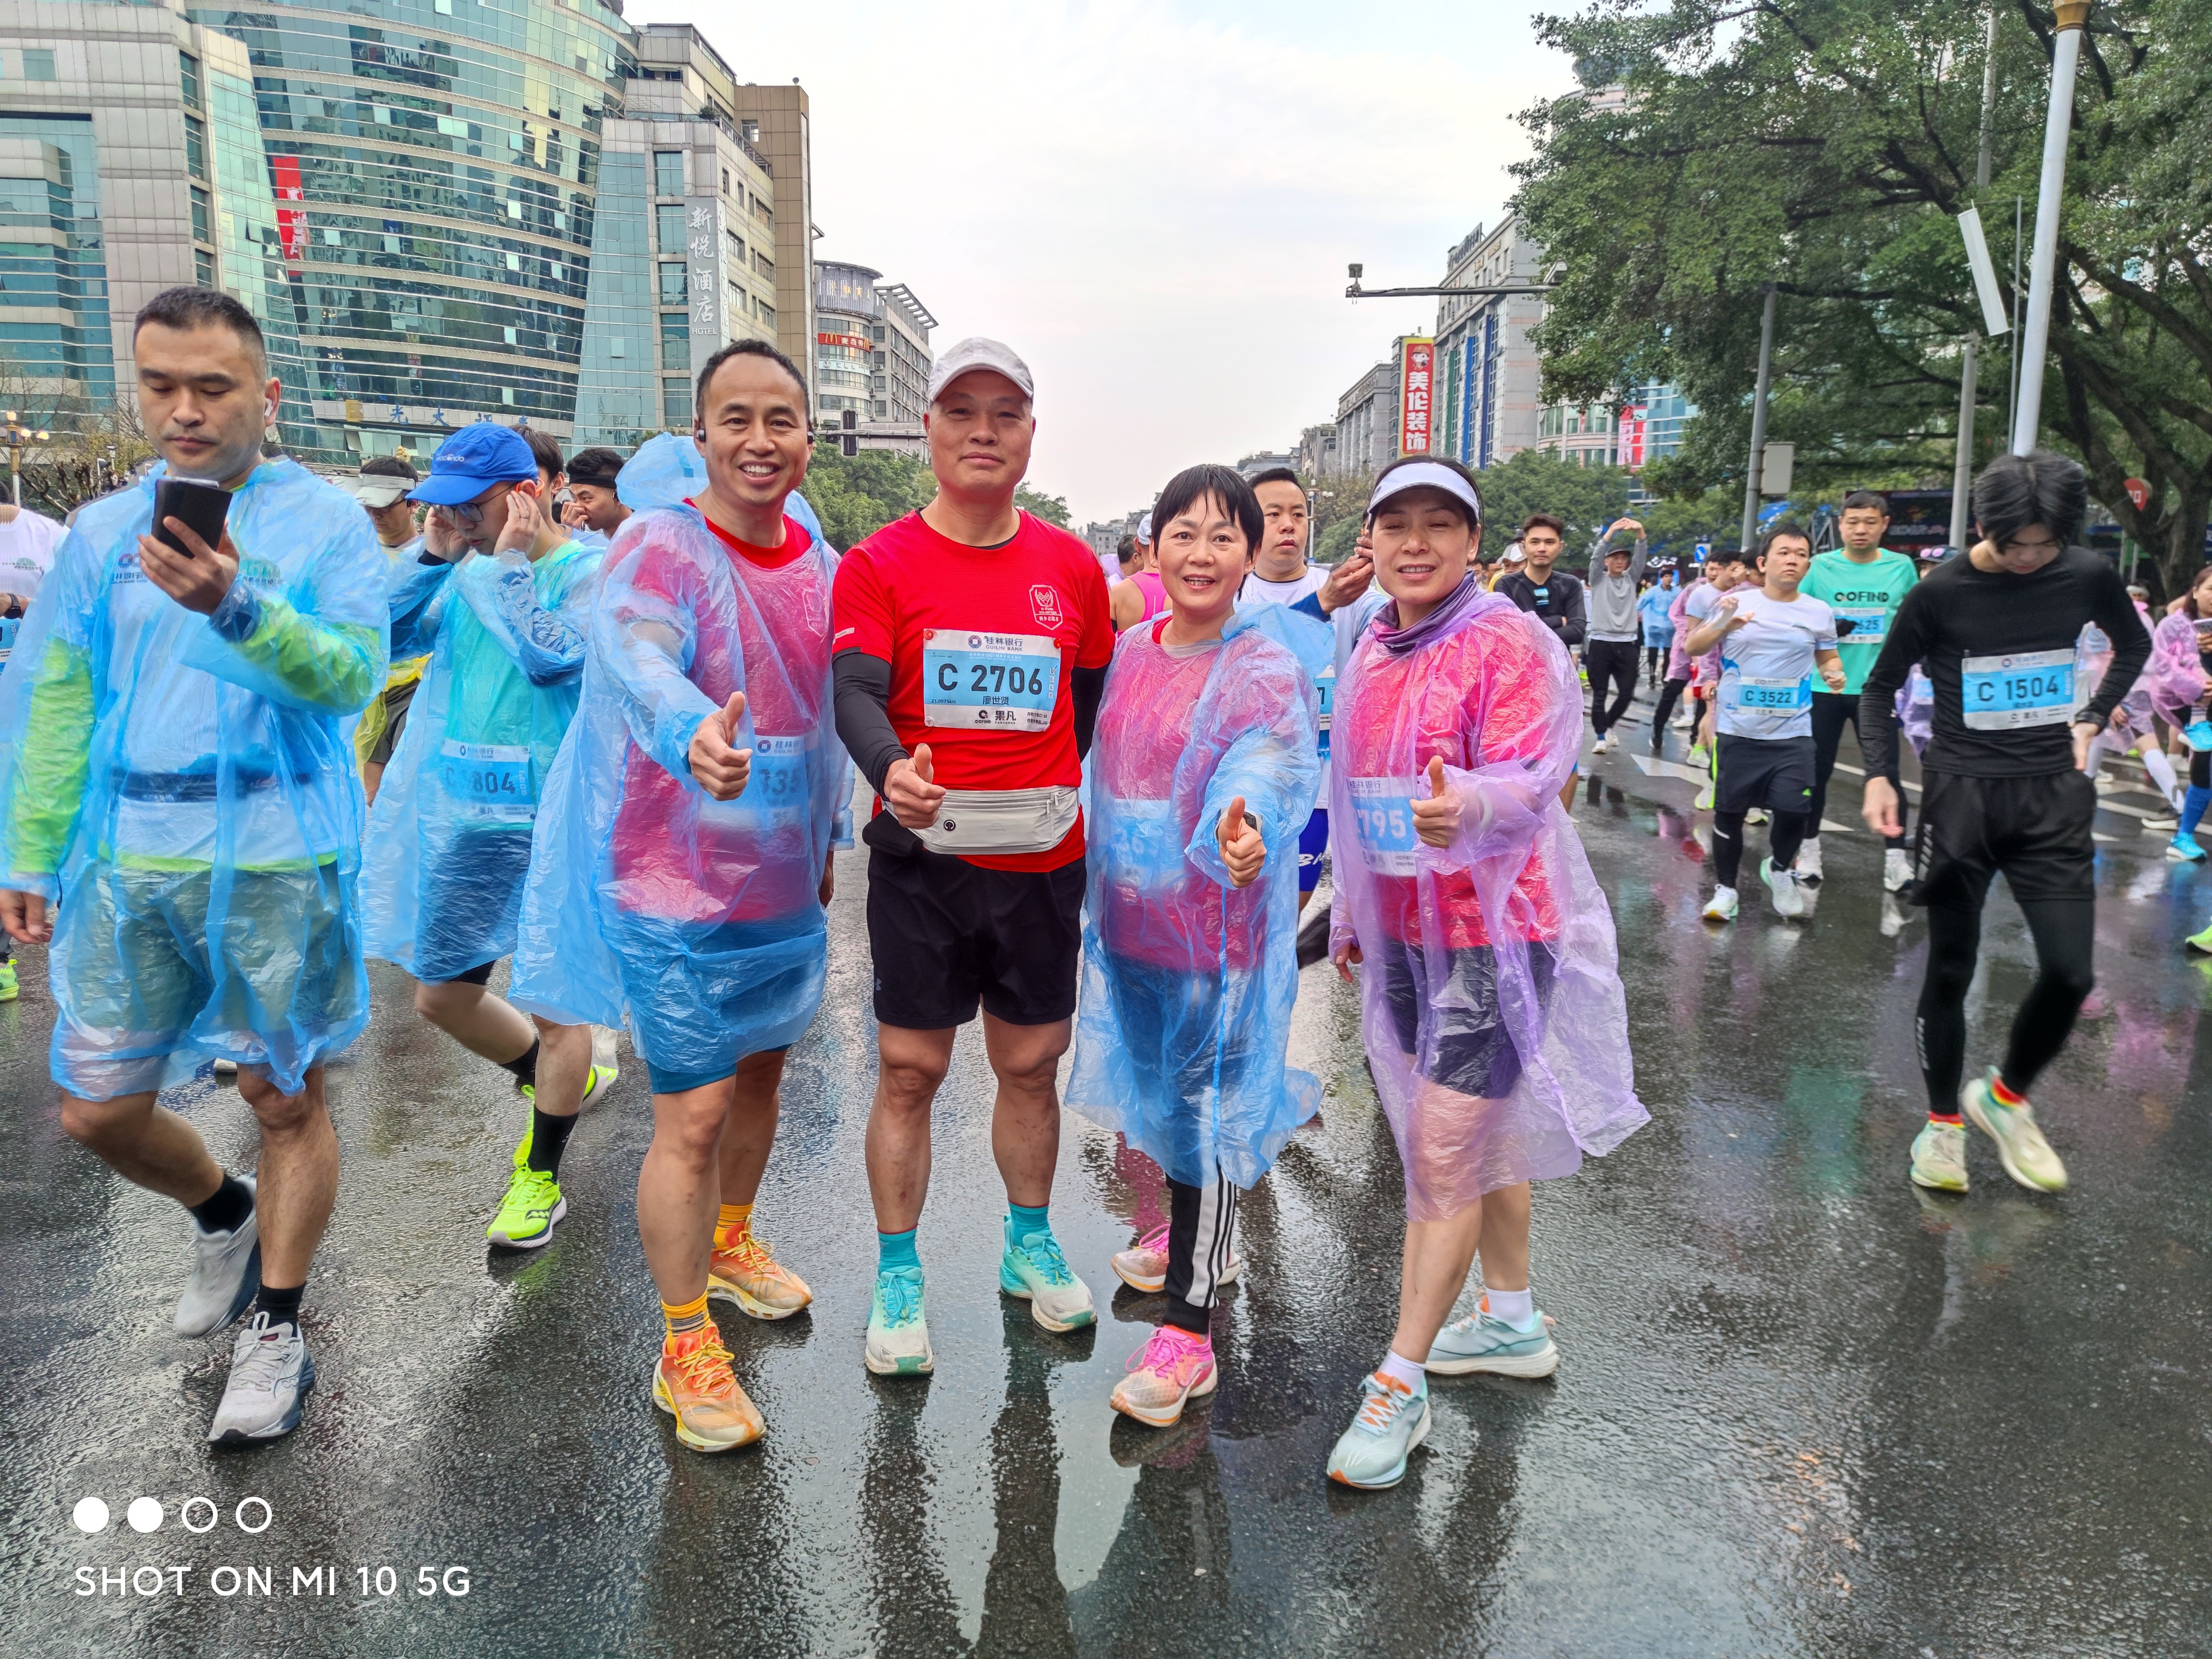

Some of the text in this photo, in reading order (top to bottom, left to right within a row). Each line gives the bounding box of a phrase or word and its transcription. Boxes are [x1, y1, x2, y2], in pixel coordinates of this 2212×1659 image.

[689, 207, 714, 323] 新悦酒店
[841, 337, 863, 347] 麦当劳
[1406, 371, 1429, 451] 美伦装饰
[1857, 619, 1879, 630] 625
[986, 636, 1023, 647] 桂林银行
[938, 663, 958, 691] C
[971, 665, 1042, 695] 2706
[1745, 690, 1792, 703] C 3522
[1978, 676, 2059, 702] C 1504
[982, 695, 1009, 705] 廖世贤
[994, 710, 1016, 721] 果凡
[471, 771, 516, 794] 804
[1357, 809, 1406, 839] 795
